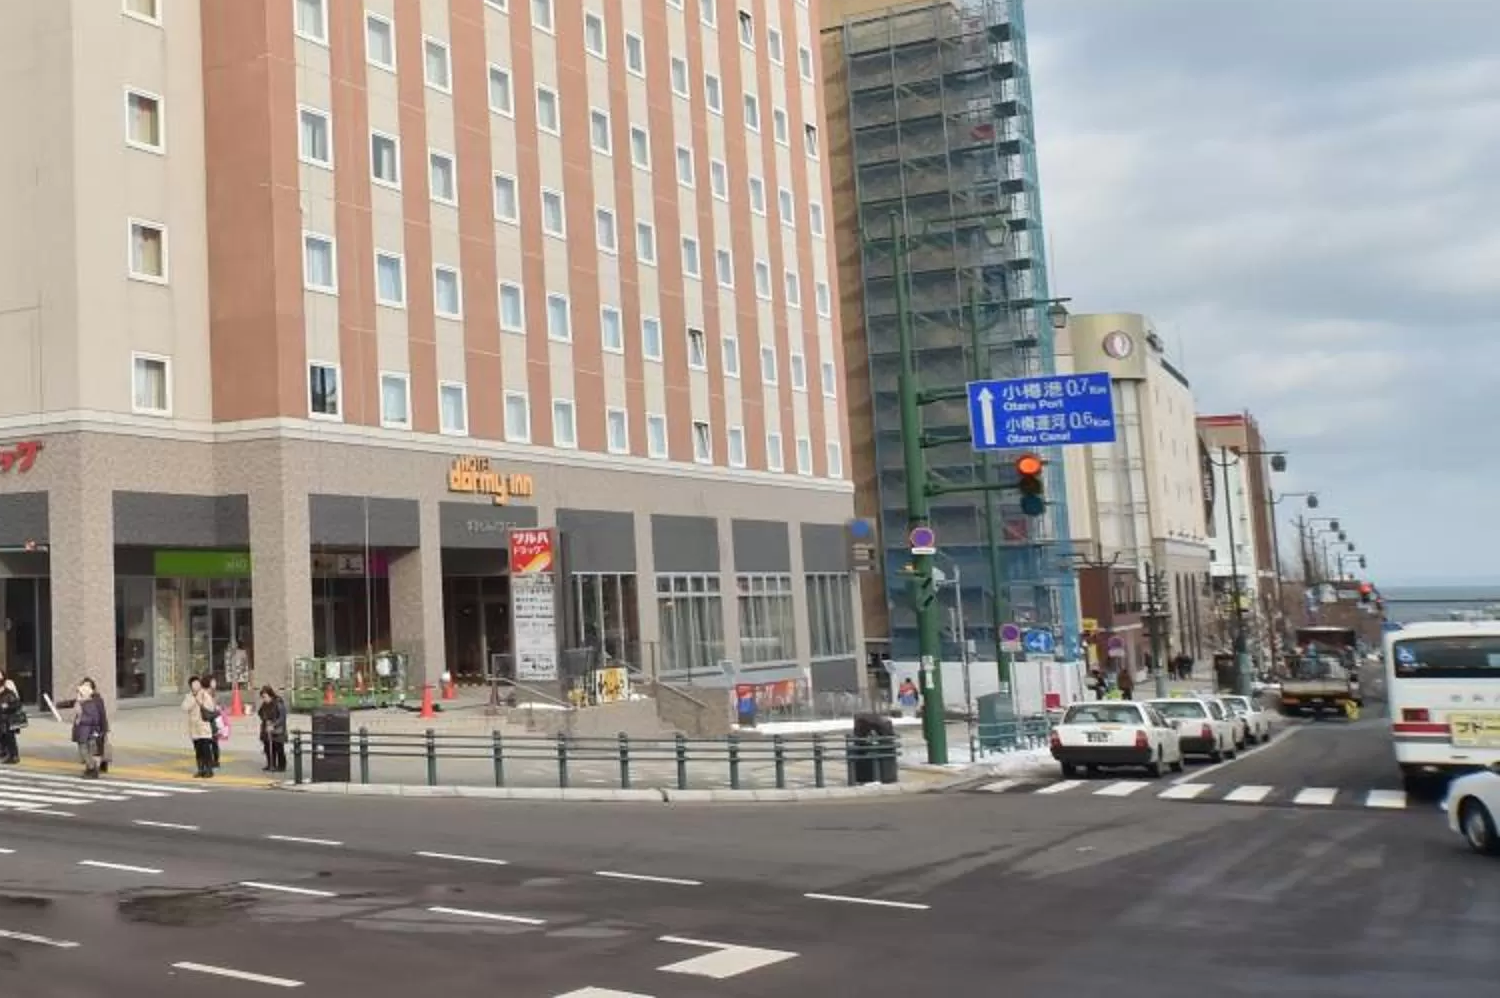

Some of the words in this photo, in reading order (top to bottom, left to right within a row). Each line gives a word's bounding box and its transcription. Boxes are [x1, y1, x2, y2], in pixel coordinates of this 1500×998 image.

[1002, 381, 1065, 401] 小樽港
[1003, 401, 1037, 412] Otaru
[1039, 399, 1064, 410] Port
[1005, 413, 1067, 433] 小樽運河
[1006, 433, 1037, 444] Otaru
[1039, 431, 1071, 443] Canal
[447, 459, 509, 506] dormy
[508, 472, 534, 497] inn
[511, 532, 549, 547] ツルハ
